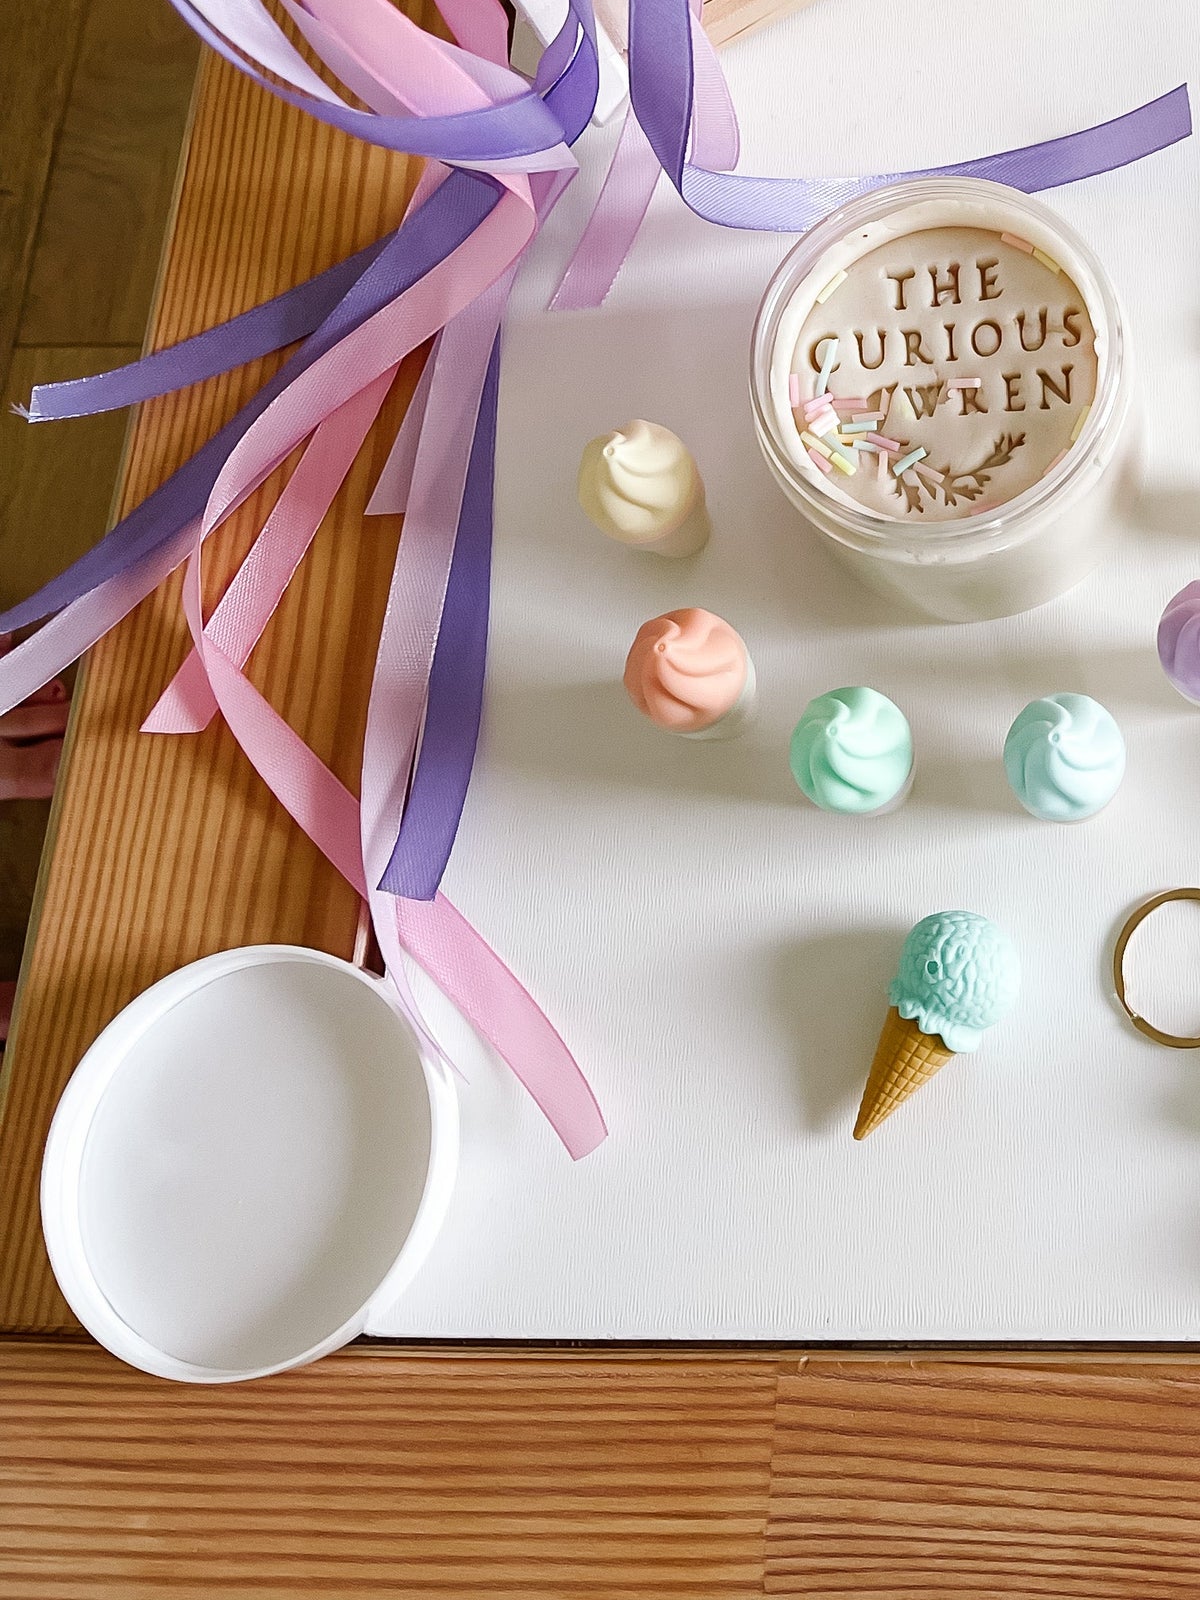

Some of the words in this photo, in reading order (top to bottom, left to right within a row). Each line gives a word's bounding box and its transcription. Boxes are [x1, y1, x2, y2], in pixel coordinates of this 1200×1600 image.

[886, 257, 1004, 311] THE
[809, 306, 1081, 374] CURIOUS
[903, 364, 1075, 420] WREN
